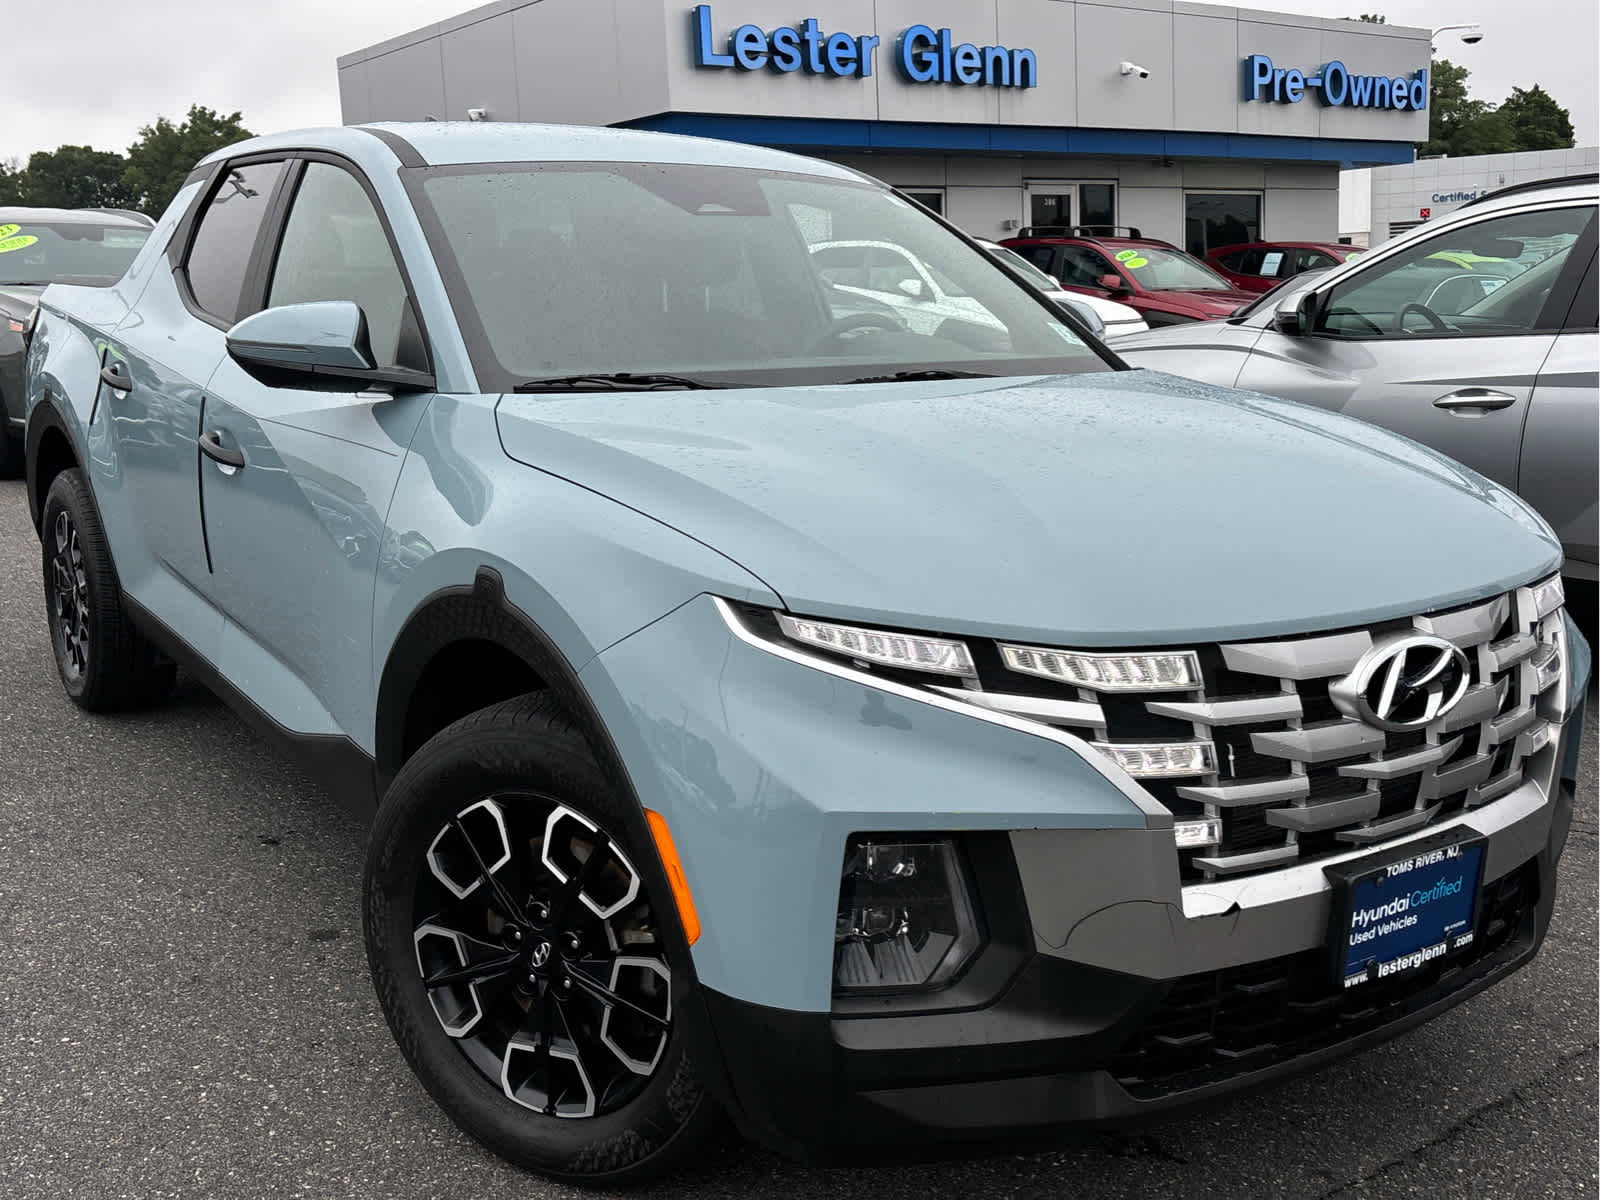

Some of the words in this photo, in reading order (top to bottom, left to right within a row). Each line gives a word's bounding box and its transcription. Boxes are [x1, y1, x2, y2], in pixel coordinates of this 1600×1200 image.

[692, 4, 880, 79] Lester
[897, 24, 1038, 89] Glenn
[1244, 54, 1428, 112] Pre-Owned
[1431, 191, 1477, 203] Certified
[1386, 860, 1414, 878] TOMS
[1415, 851, 1445, 869] RIVER,
[1351, 893, 1410, 929] Hyundai
[1410, 875, 1463, 907] Certified
[1349, 926, 1376, 946] Used
[1377, 914, 1418, 937] Vehicles
[1377, 943, 1447, 979] lesterglenn
